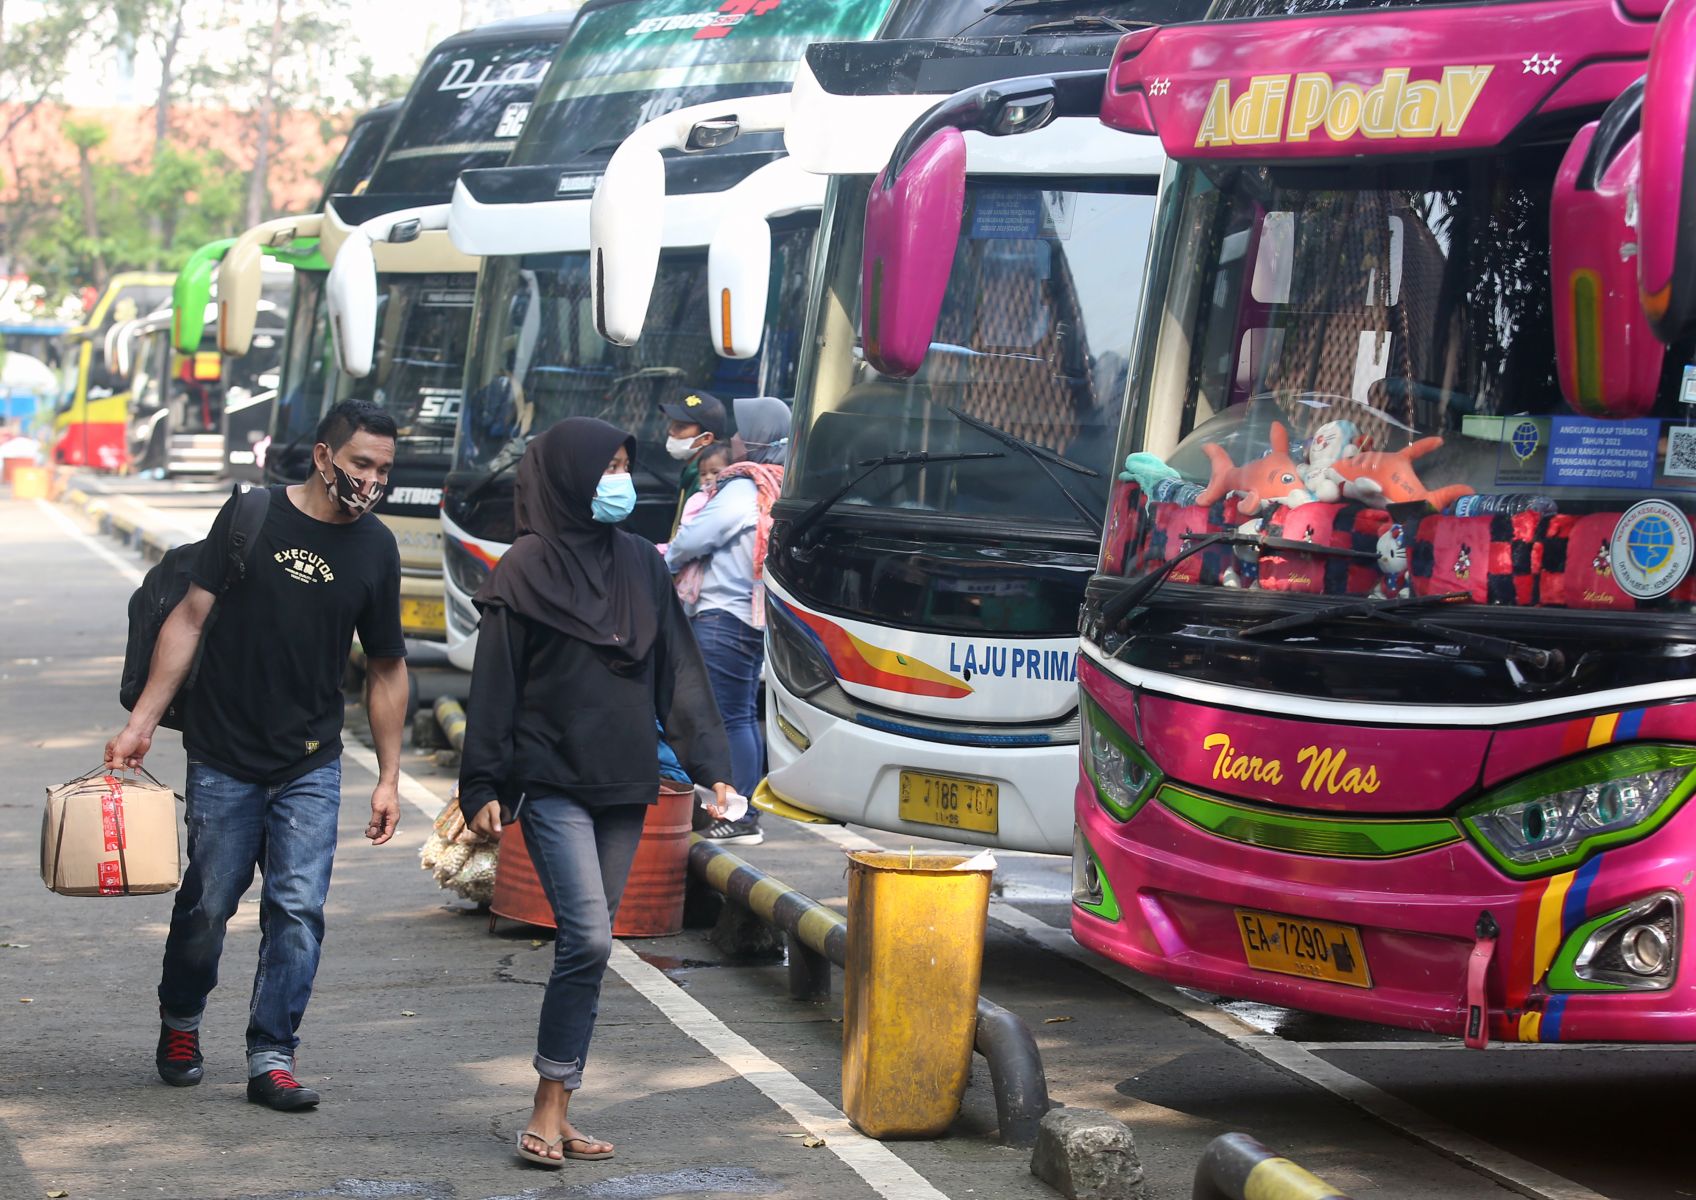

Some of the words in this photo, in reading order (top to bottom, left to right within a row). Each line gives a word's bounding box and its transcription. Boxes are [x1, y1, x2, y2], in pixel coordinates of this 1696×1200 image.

[625, 12, 720, 35] JETBUS
[1194, 74, 1291, 147] Adi
[1560, 426, 1595, 435] ANGKUTAN
[1595, 427, 1614, 436] AKAP
[1615, 427, 1648, 436] TERBATAS
[1582, 437, 1604, 445] TAHUN
[1605, 437, 1621, 446] 2021
[1554, 447, 1578, 455] DALAM
[1578, 448, 1605, 456] RANGKA
[1606, 449, 1648, 457] PERCEPATAN
[1552, 457, 1596, 466] PENANGANAN
[1597, 459, 1627, 467] CORONA
[1627, 459, 1648, 468] VIRUS
[1559, 469, 1584, 477] DISEASE
[1585, 469, 1601, 478] 2019
[387, 487, 442, 504] JETBUS
[274, 549, 334, 583] EXECUTOR
[950, 642, 1007, 677] LAJU
[1203, 733, 1283, 786] Tiara
[1297, 745, 1380, 795] Mas
[1242, 916, 1272, 953] EA
[1277, 922, 1328, 962] 7290
